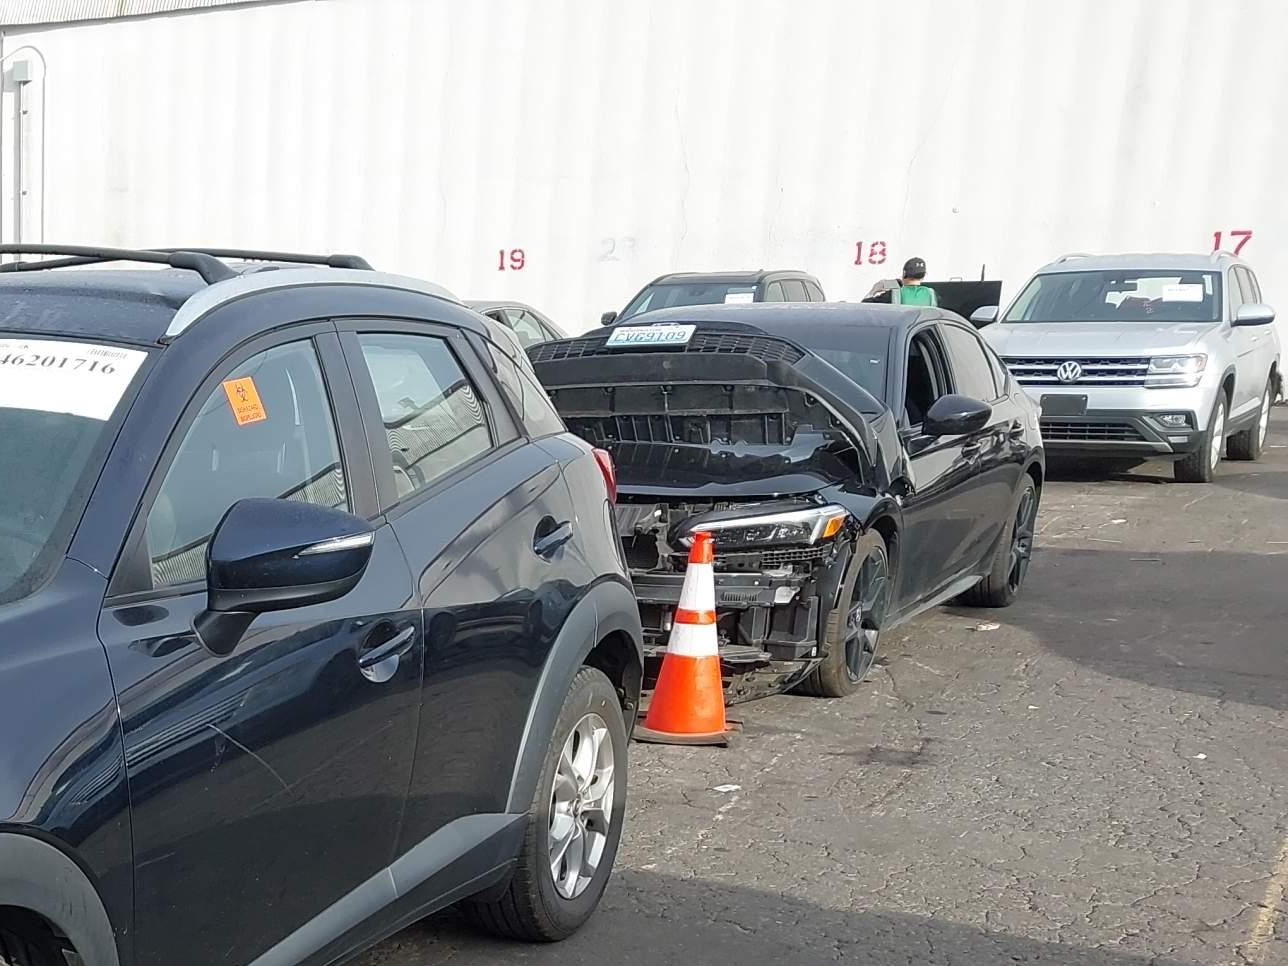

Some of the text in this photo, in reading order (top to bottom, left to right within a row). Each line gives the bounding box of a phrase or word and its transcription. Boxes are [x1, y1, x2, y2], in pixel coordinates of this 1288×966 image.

[854, 241, 887, 265] 18
[1212, 231, 1253, 256] 17
[497, 249, 525, 271] 19
